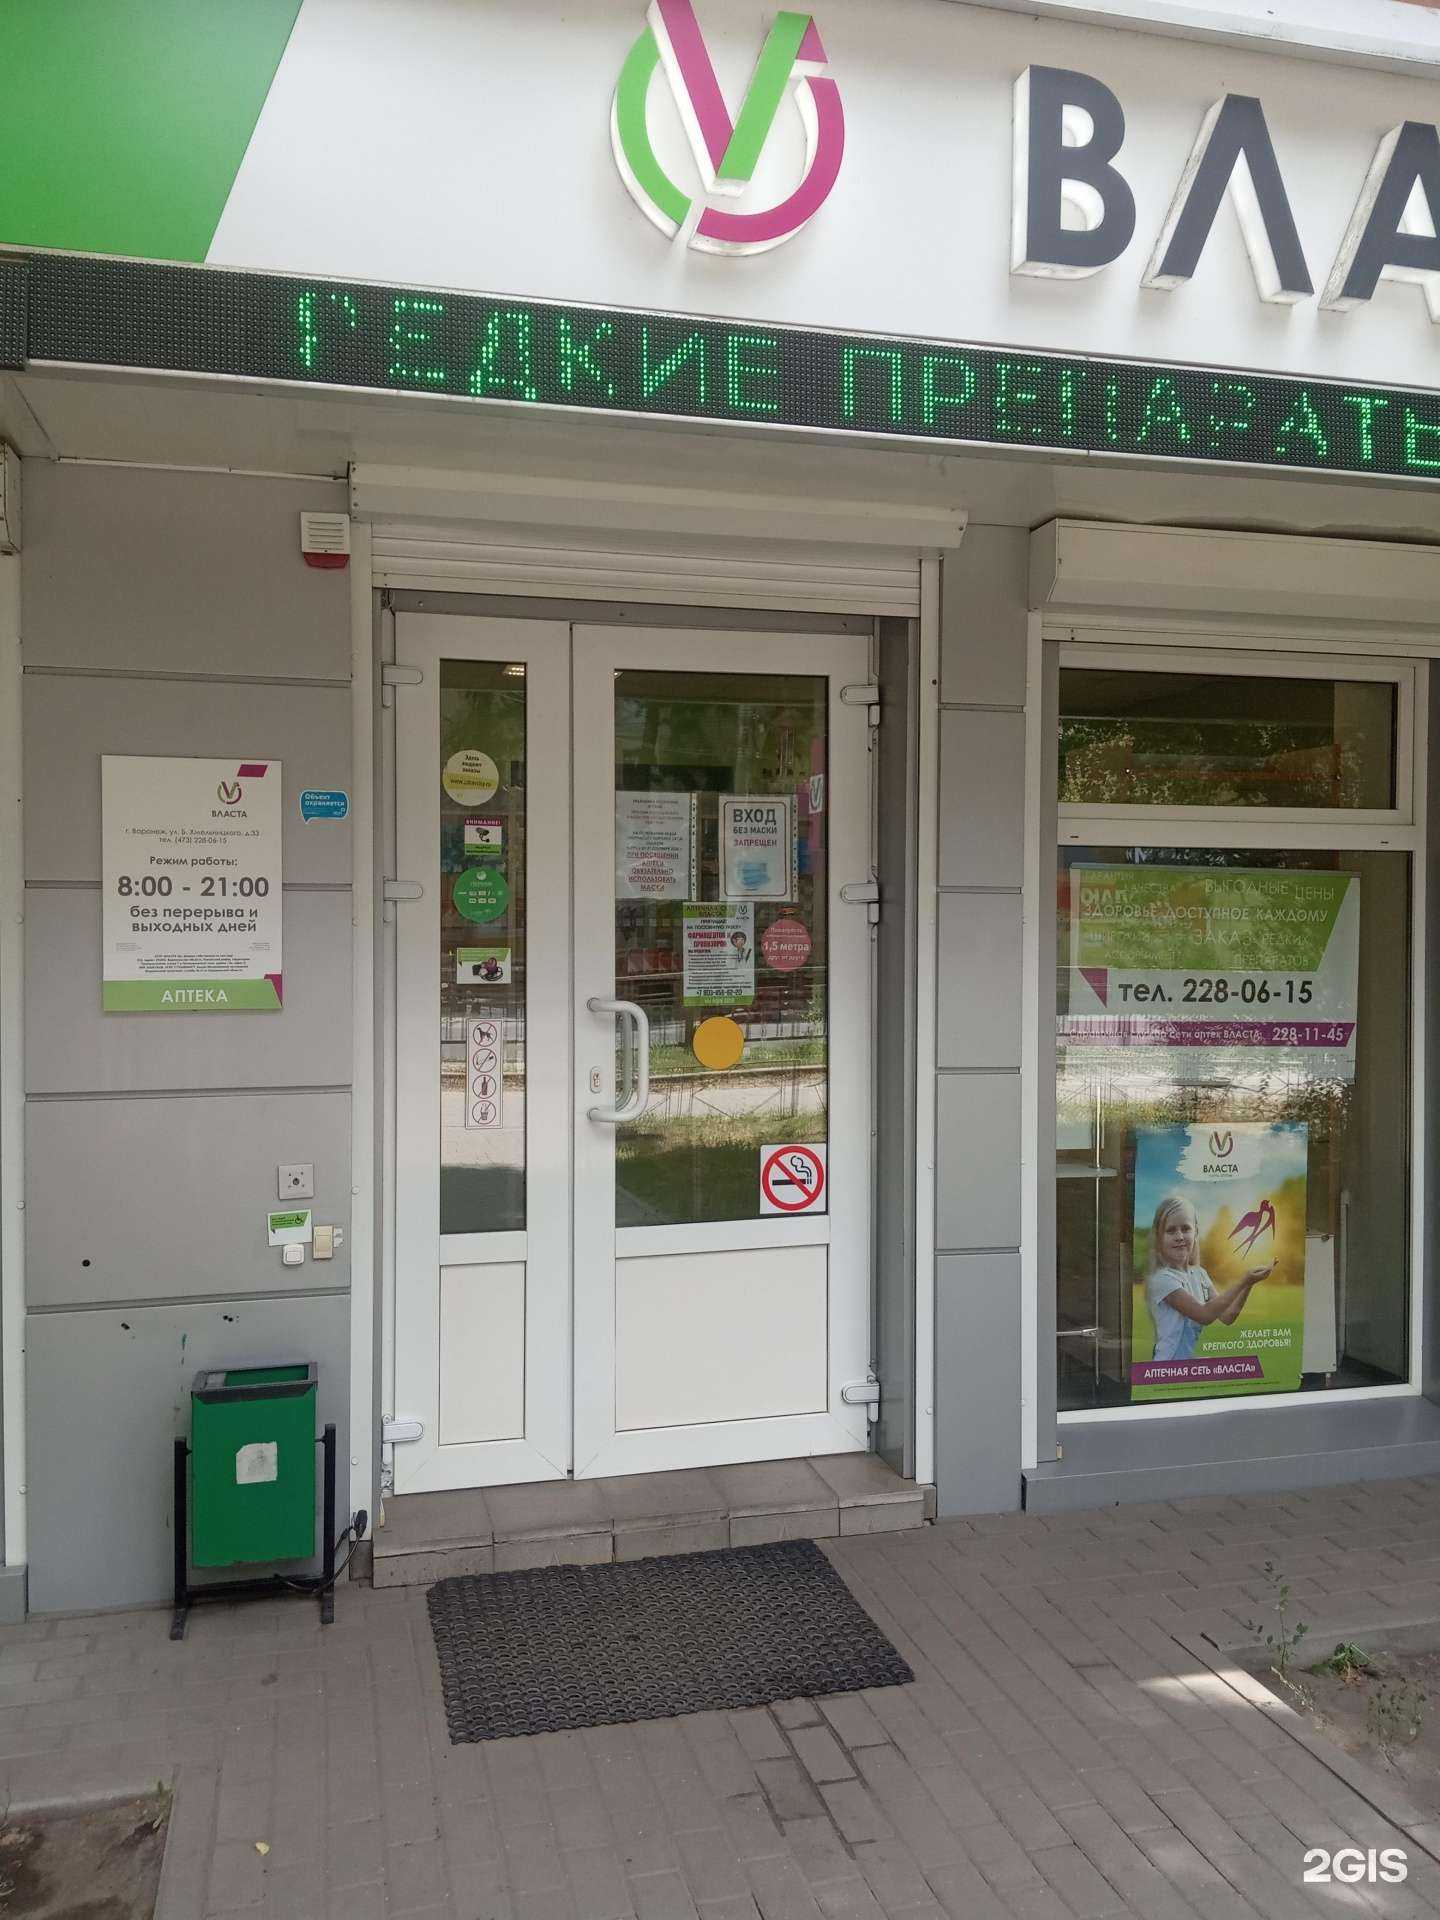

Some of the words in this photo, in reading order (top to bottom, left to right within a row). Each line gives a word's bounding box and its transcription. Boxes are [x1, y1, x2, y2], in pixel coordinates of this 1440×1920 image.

[211, 809, 248, 818] ВЛАСТА
[732, 808, 777, 826] ВХОД
[732, 826, 748, 835] БЕЗ
[750, 826, 777, 835] МАСКИ
[733, 838, 777, 847] ЗАПРЕЩЕН
[150, 856, 188, 866] Режим
[191, 856, 239, 868] работы:
[117, 875, 172, 897] 8:00
[200, 876, 269, 898] 21:00
[1205, 879, 1289, 896] ВЫГОДНЫЕ
[1295, 885, 1335, 900] ЦЕНЫ
[130, 905, 158, 919] без
[163, 906, 244, 921] перерыва
[249, 908, 258, 919] и
[1082, 903, 1157, 919] ЗДОРОВЬЕ
[1166, 905, 1249, 920] ДОСТУПНОЕ
[1256, 908, 1328, 922] КАЖДОМУ
[132, 921, 213, 934] выходных
[218, 919, 257, 934] дней
[763, 941, 778, 951] 1,5
[780, 942, 809, 953] метра
[161, 989, 229, 1003] АПТЕКА
[1118, 983, 1172, 1003] тел.
[1182, 978, 1314, 1005] 228-06-15
[1272, 1026, 1345, 1042] 228-11-45
[1203, 1164, 1239, 1174] ВЛАСТА
[1240, 1329, 1272, 1339] ЖЕЛАЕТ
[1273, 1328, 1292, 1338] ВАМ
[1202, 1340, 1245, 1352] КРЕПКОГО
[1144, 1366, 1189, 1379] АПТЕЧНАЯ
[1191, 1365, 1211, 1376] СЕТЬ
[1213, 1363, 1256, 1375] «ВЛАСТА»
